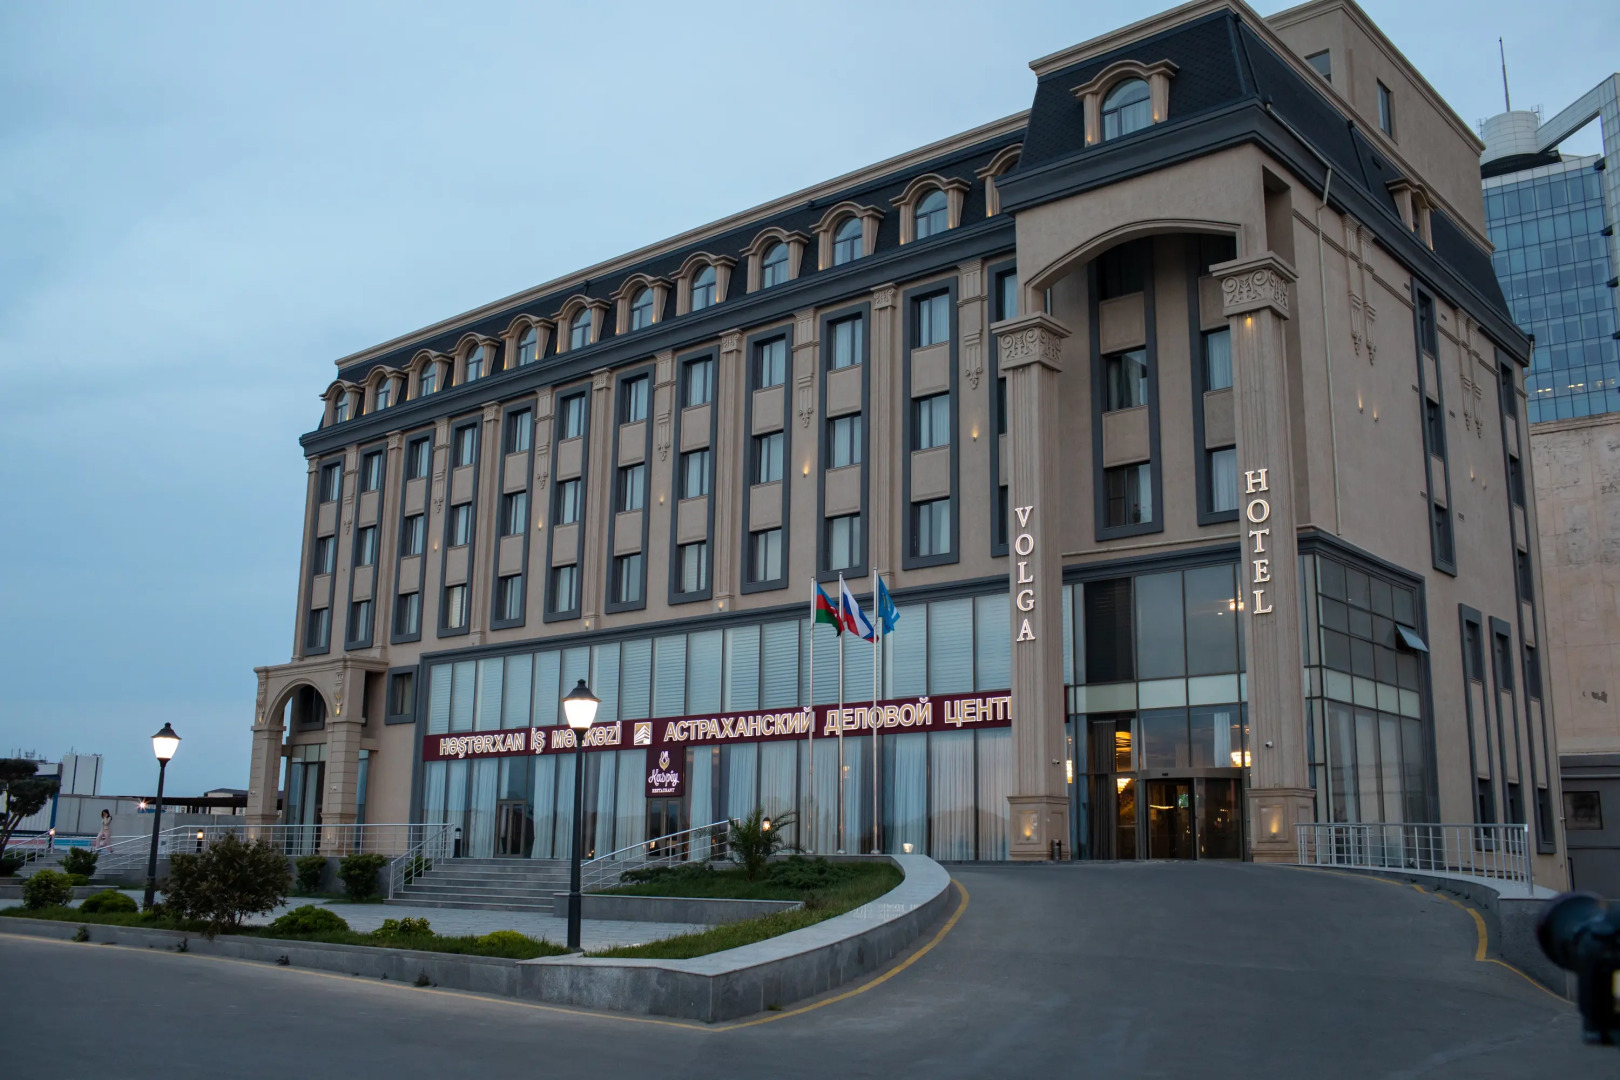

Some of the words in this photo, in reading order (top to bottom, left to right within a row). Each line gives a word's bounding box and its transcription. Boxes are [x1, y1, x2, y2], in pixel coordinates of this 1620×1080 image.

[1244, 468, 1273, 615] HOTEL
[1014, 505, 1036, 642] VOLGA
[439, 732, 525, 759] HƏŞTƏRXAN
[530, 727, 546, 754] İŞ
[551, 720, 622, 749] MƏKƏZİ
[664, 706, 816, 742] АСТРАХАНСКИЙ
[824, 697, 933, 736] ДЕЛОВОЙ
[648, 768, 680, 787] Kaspiy
